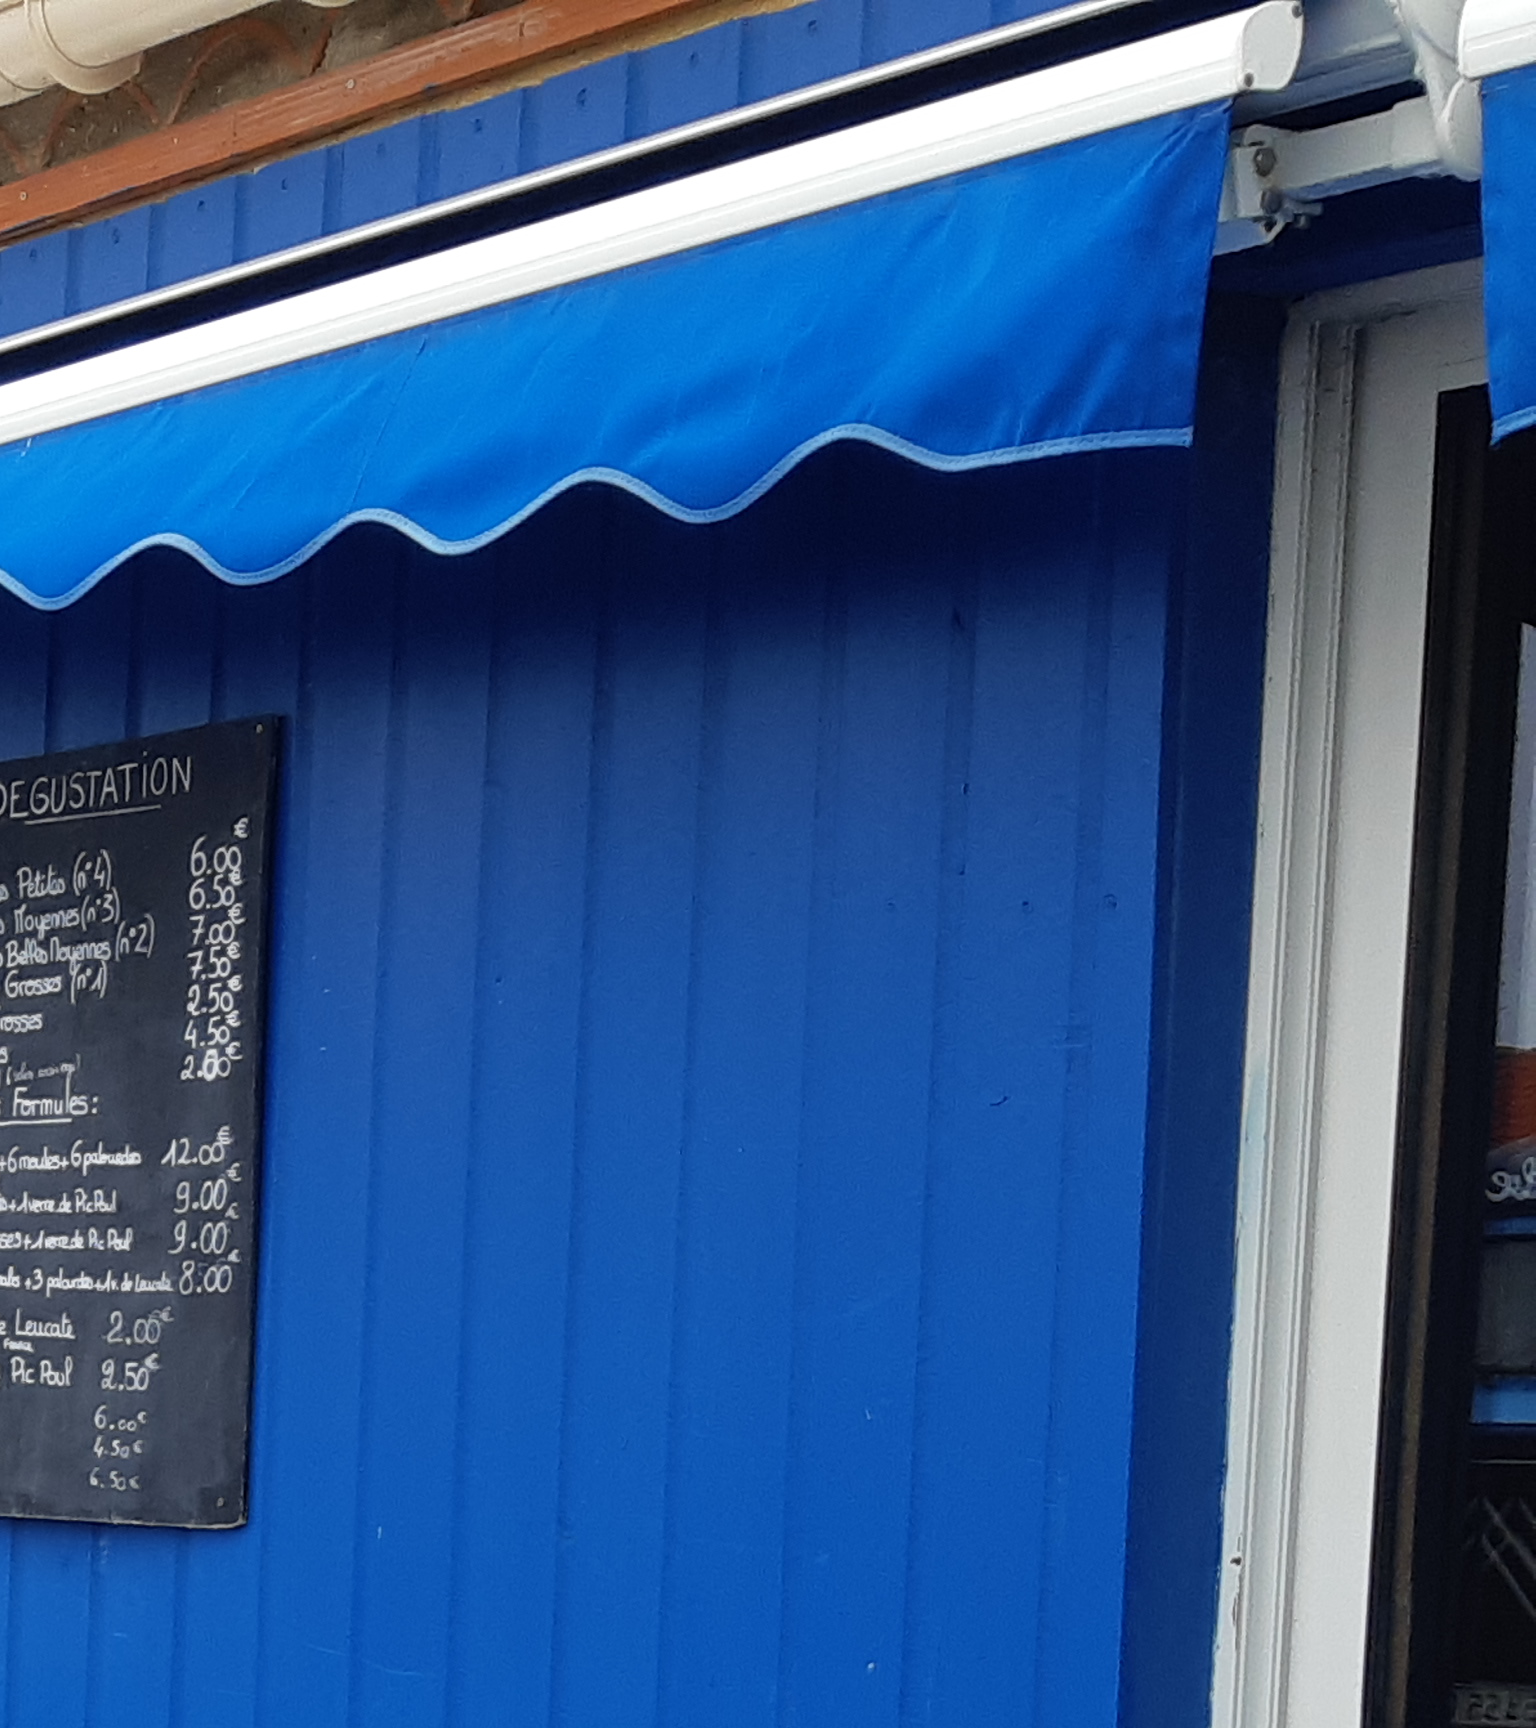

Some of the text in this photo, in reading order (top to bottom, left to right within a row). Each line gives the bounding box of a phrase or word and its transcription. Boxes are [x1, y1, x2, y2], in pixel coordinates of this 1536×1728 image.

[14, 1308, 75, 1339] Leucate
[10, 1356, 35, 1384] Pic
[40, 1355, 74, 1386] Poul
